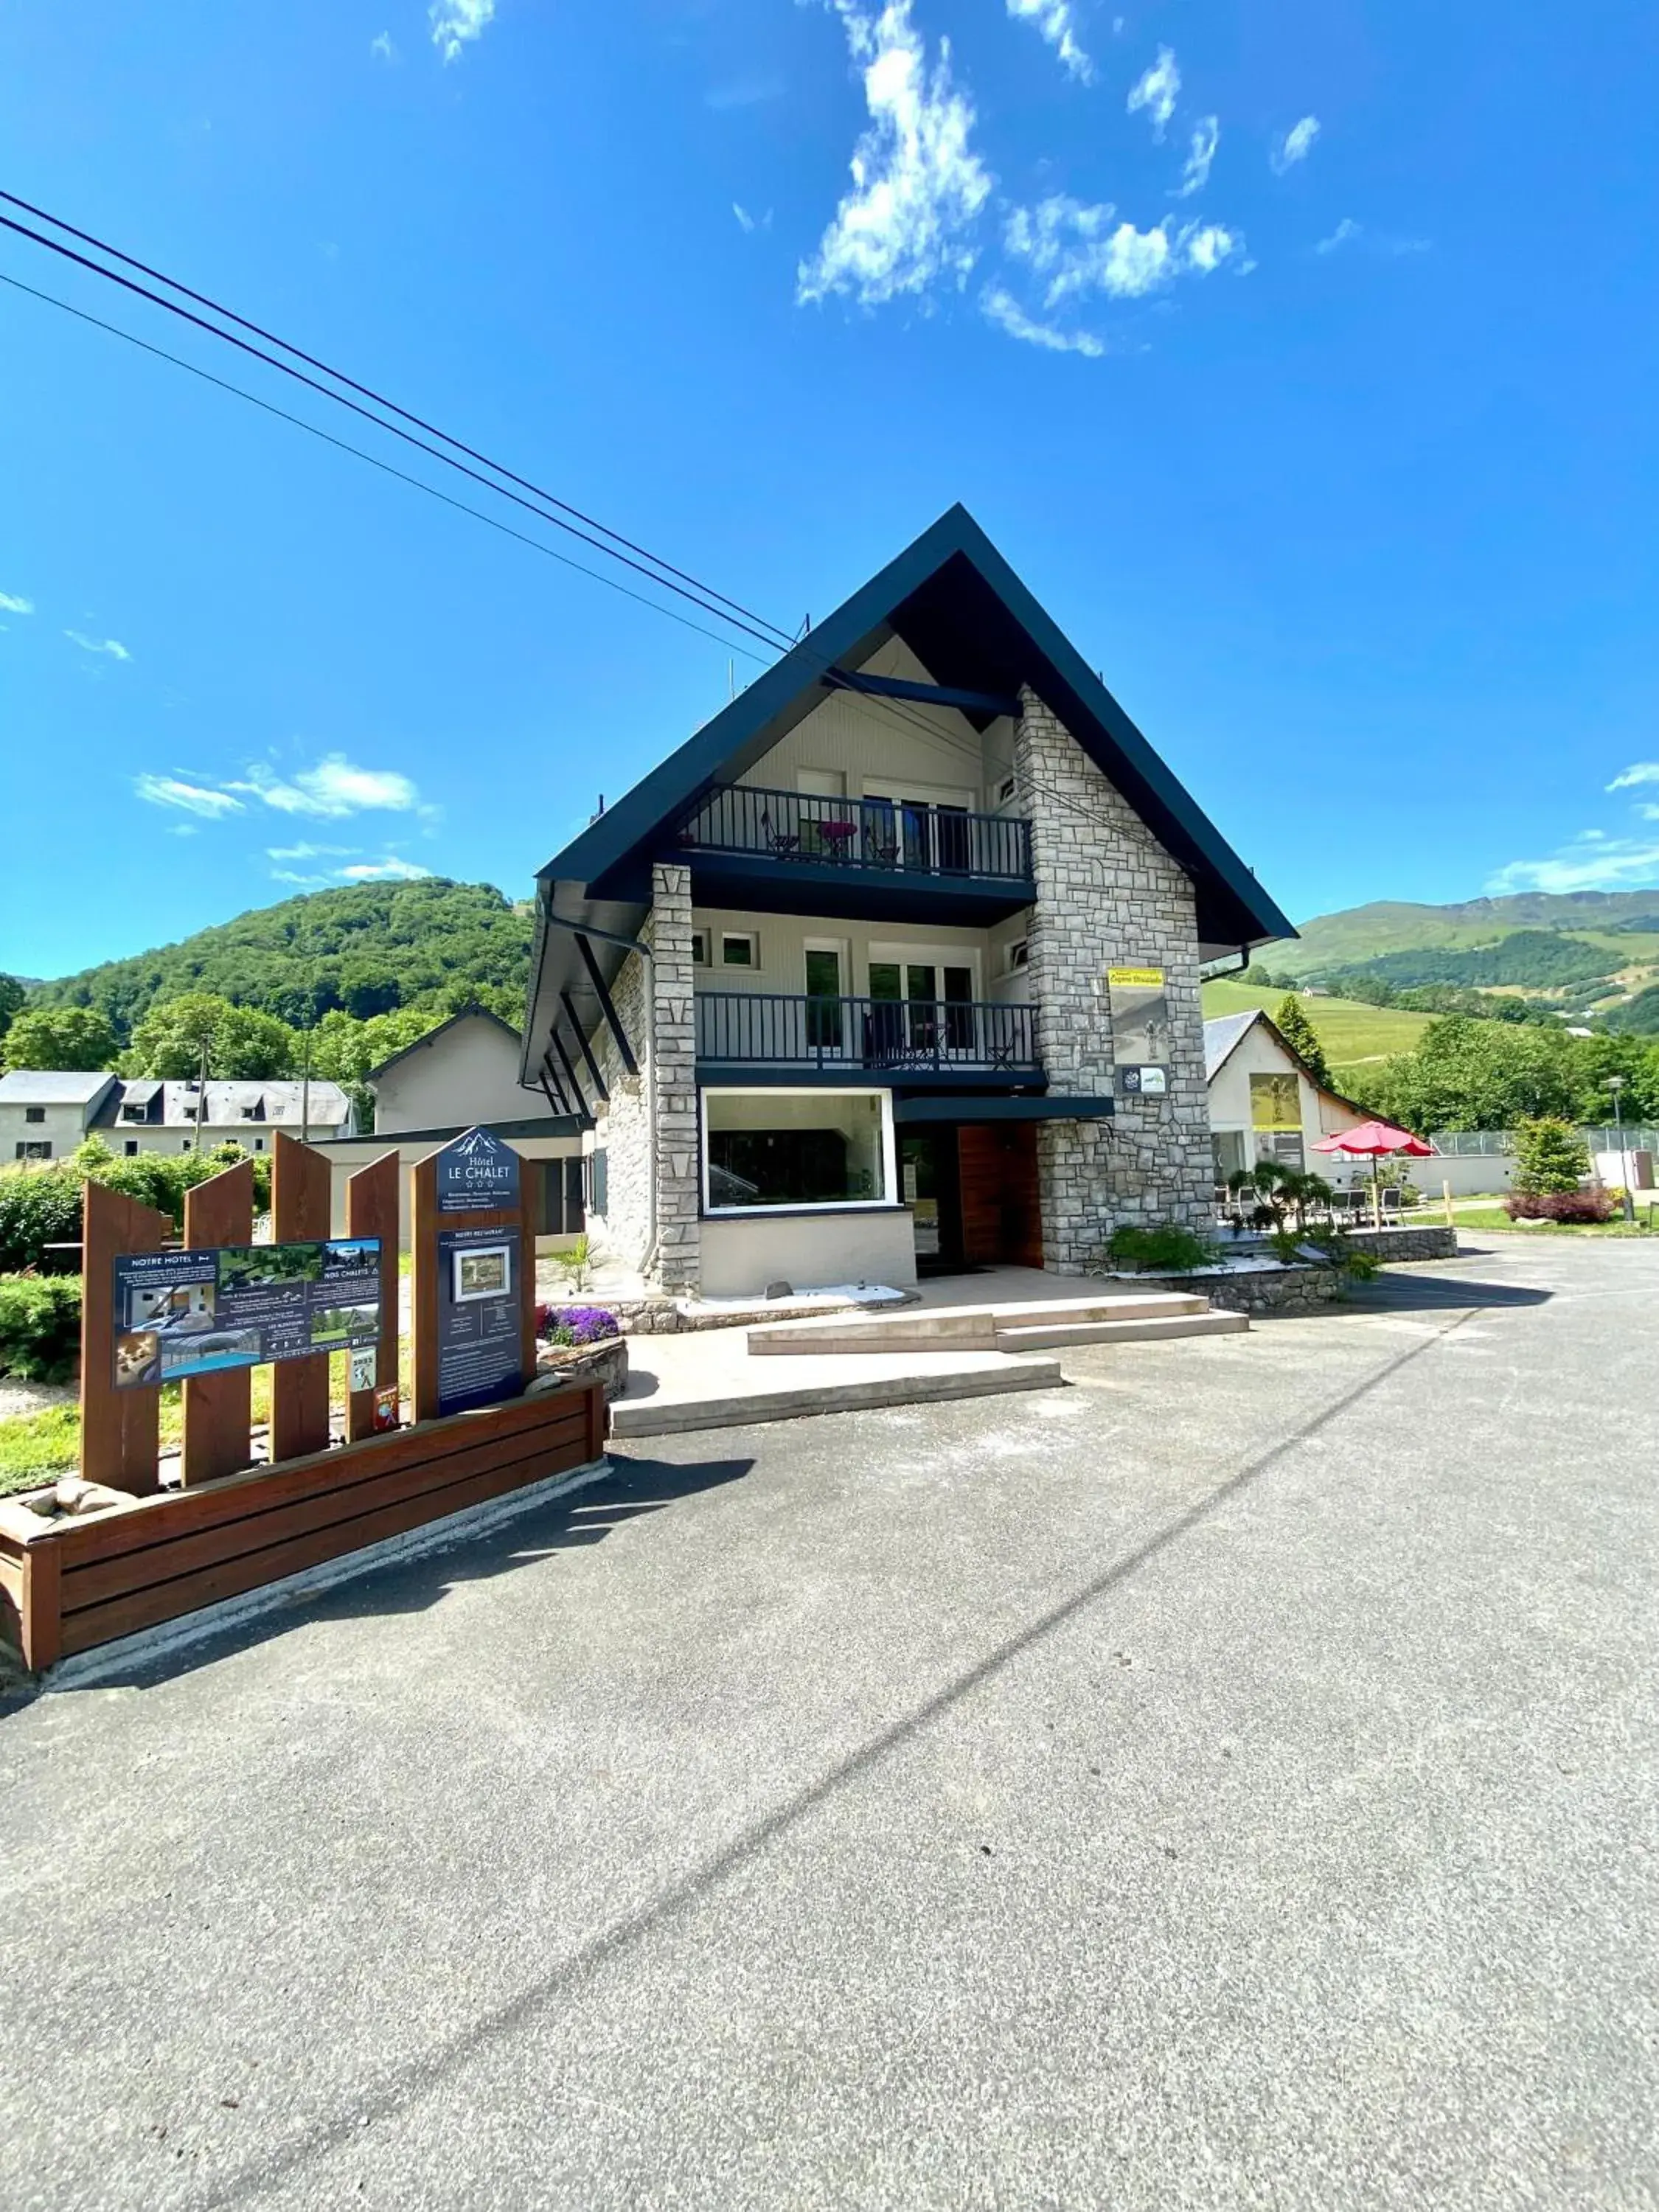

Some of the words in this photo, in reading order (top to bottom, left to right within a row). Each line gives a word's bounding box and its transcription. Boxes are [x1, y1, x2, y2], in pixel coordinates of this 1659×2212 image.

[469, 1156, 493, 1166] Hôtel
[449, 1167, 461, 1179] LE
[465, 1166, 509, 1179] CHALET
[132, 1258, 162, 1267] NOTRE
